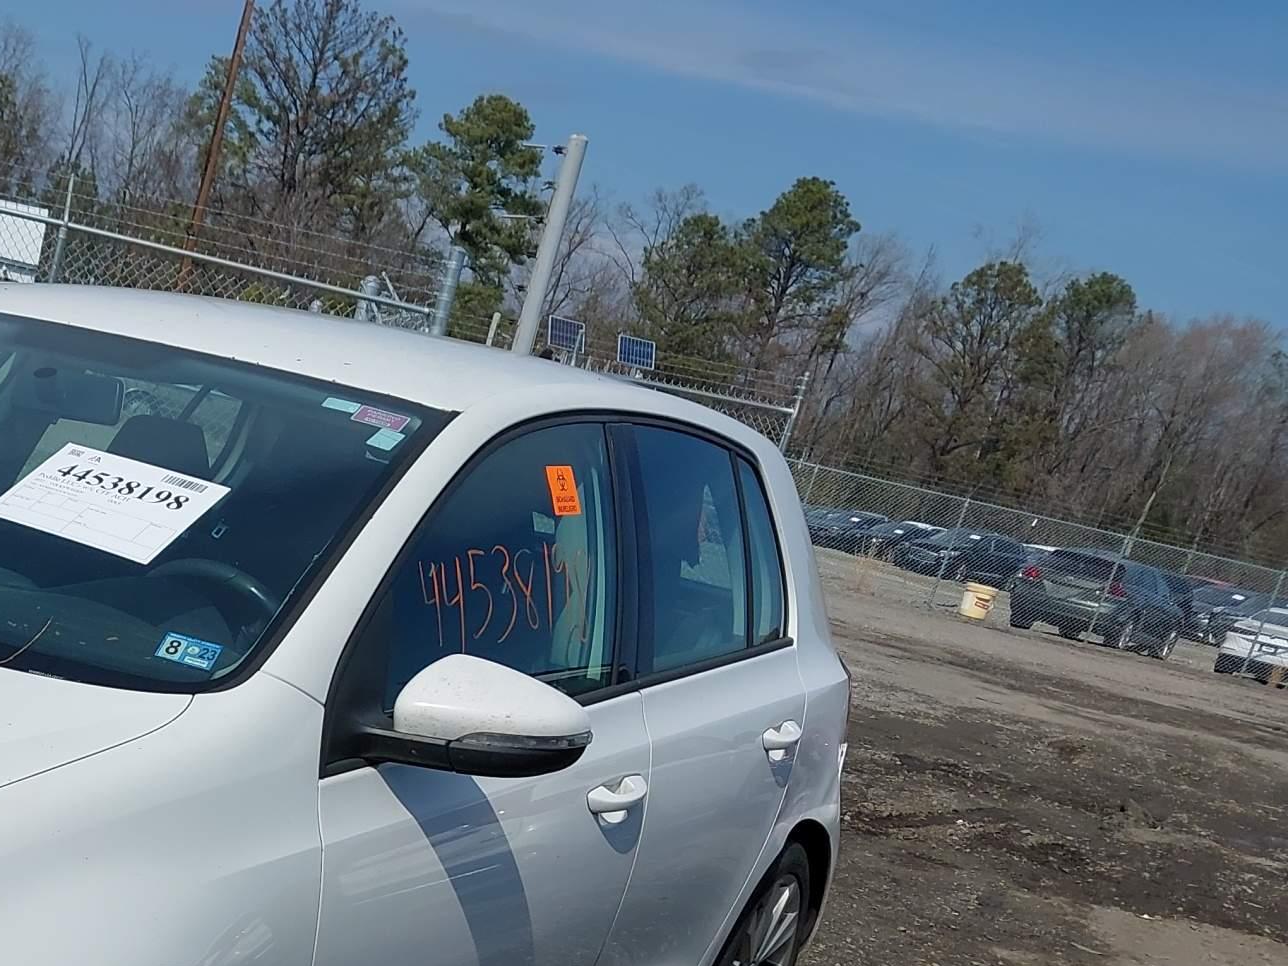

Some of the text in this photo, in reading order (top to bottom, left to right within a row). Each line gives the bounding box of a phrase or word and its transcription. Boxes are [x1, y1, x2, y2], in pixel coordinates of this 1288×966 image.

[57, 464, 190, 510] 44538198
[165, 640, 182, 655] 8
[199, 648, 218, 661] 23
